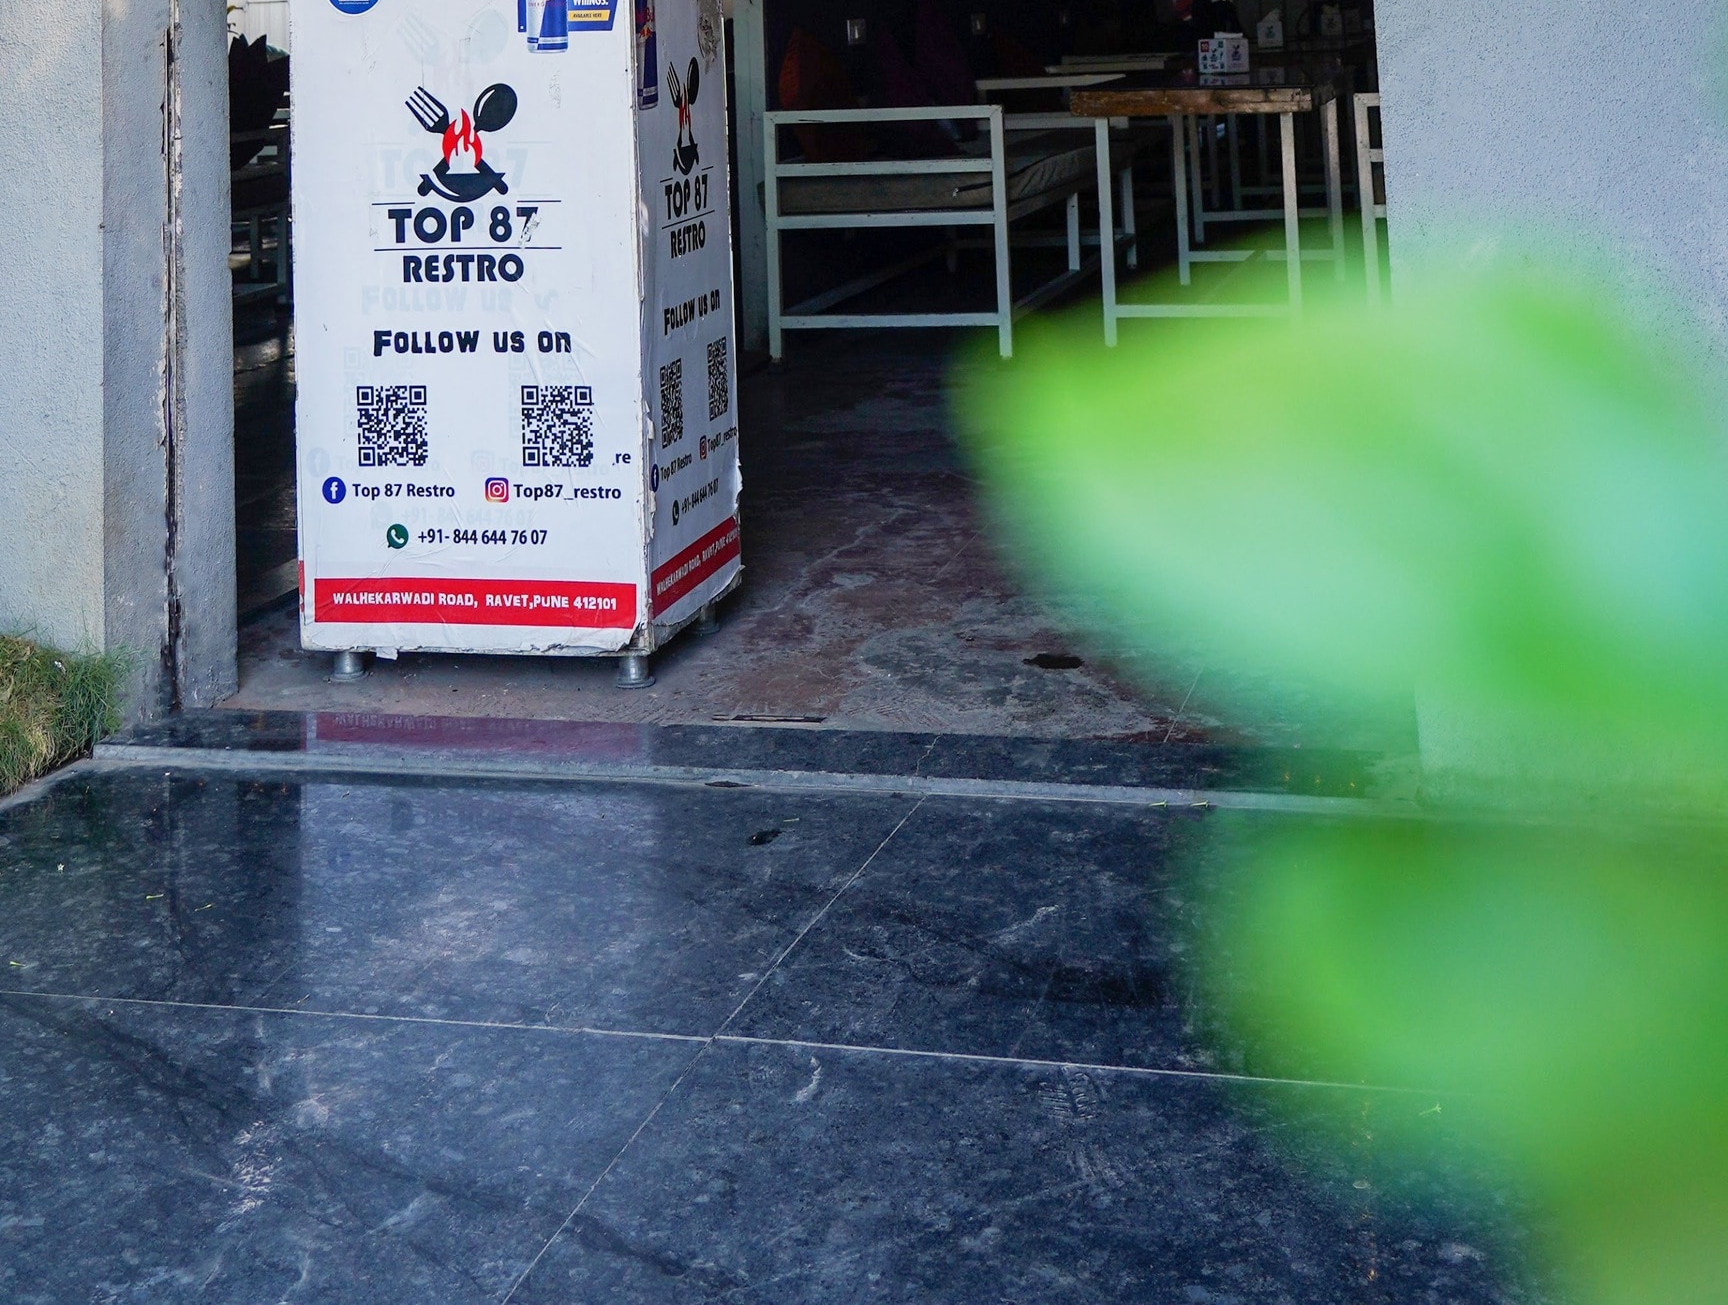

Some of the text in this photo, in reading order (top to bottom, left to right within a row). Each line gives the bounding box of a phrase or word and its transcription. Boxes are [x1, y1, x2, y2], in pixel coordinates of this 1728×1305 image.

[664, 173, 708, 220] TOP 87
[387, 205, 539, 244] TOP 87
[670, 220, 706, 259] RESTRO
[403, 253, 525, 283] RESTRO
[677, 453, 692, 471] Restro
[352, 483, 456, 501] Top 87 Restro
[513, 483, 622, 502] Top87_restro
[417, 529, 548, 545] +91- 844 644 76 07
[332, 591, 435, 606] WALHEKARWADI
[438, 593, 478, 609] ROAD,
[573, 596, 617, 611] 412101
